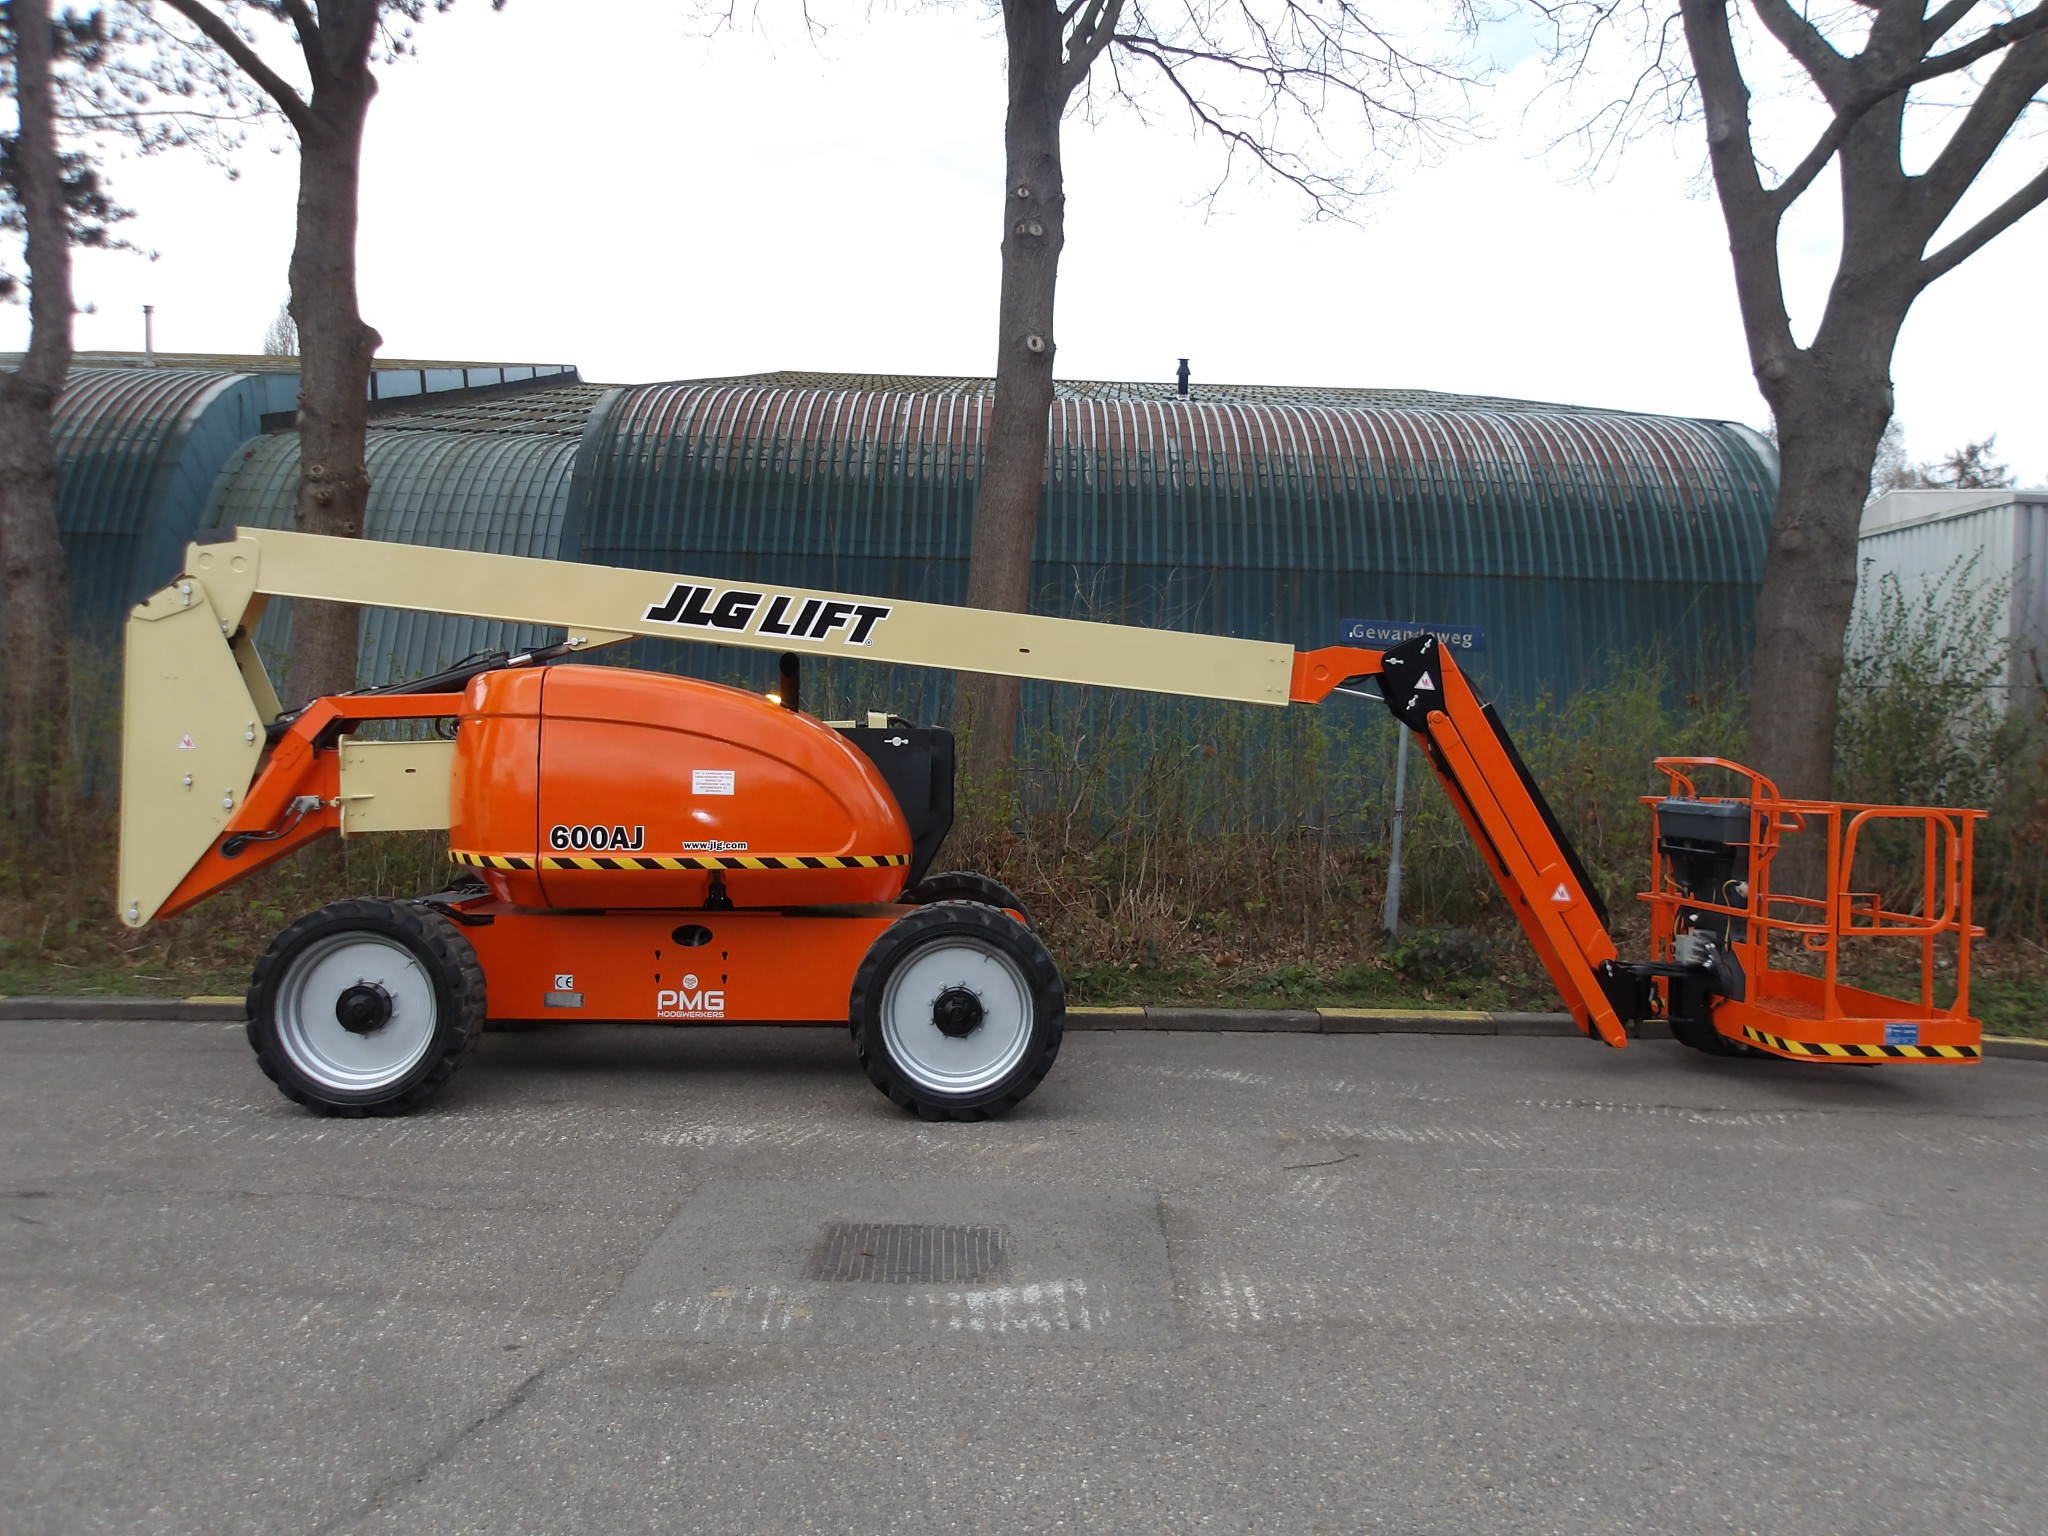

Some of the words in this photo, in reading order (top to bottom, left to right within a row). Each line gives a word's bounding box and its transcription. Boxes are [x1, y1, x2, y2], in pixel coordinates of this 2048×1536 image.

[644, 584, 763, 631] JLG
[757, 596, 892, 643] LIFT
[551, 826, 644, 850] 600AJ
[683, 840, 747, 851] www.jlg.com
[556, 976, 573, 989] CE
[657, 991, 725, 1010] PMG
